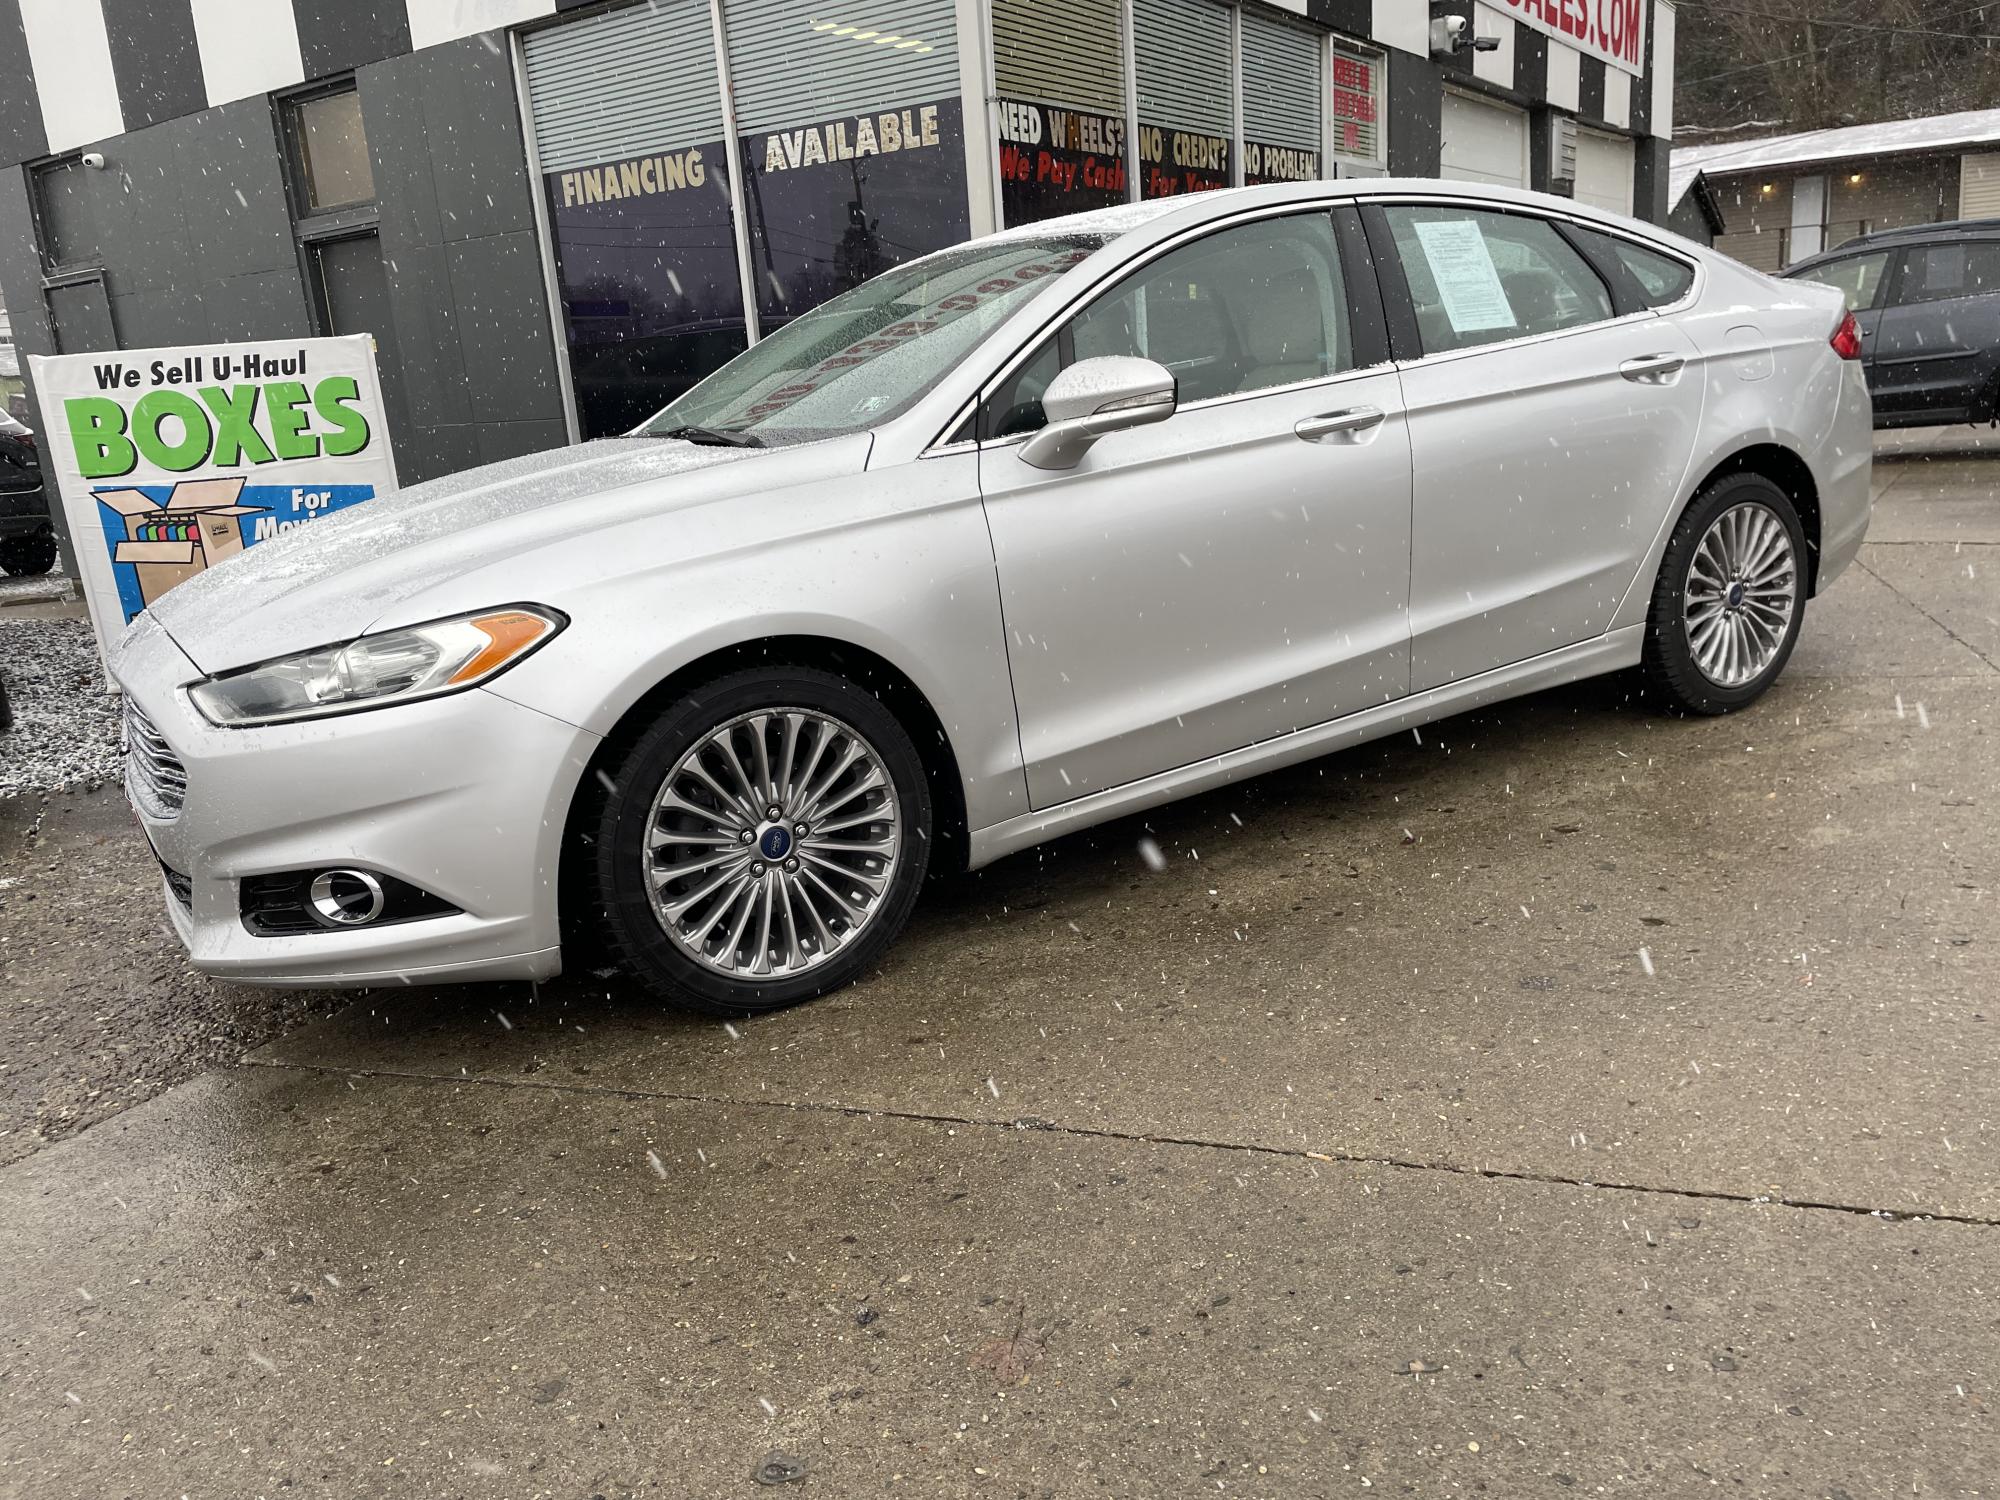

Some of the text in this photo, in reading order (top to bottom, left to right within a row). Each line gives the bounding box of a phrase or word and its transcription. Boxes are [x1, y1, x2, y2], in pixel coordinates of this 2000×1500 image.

[765, 105, 940, 173] AVAILABLE
[999, 101, 1125, 158] NEED WHEELS?
[1139, 126, 1228, 173] NO CREDIT?
[561, 150, 705, 208] FINANCING
[1000, 145, 1125, 193] We Pay Cash
[1150, 168, 1178, 196] For
[1244, 143, 1318, 181] NO PROBLEM!
[94, 350, 306, 390] We Sell U-Haul
[64, 376, 371, 478] BOXES
[291, 488, 331, 512] For
